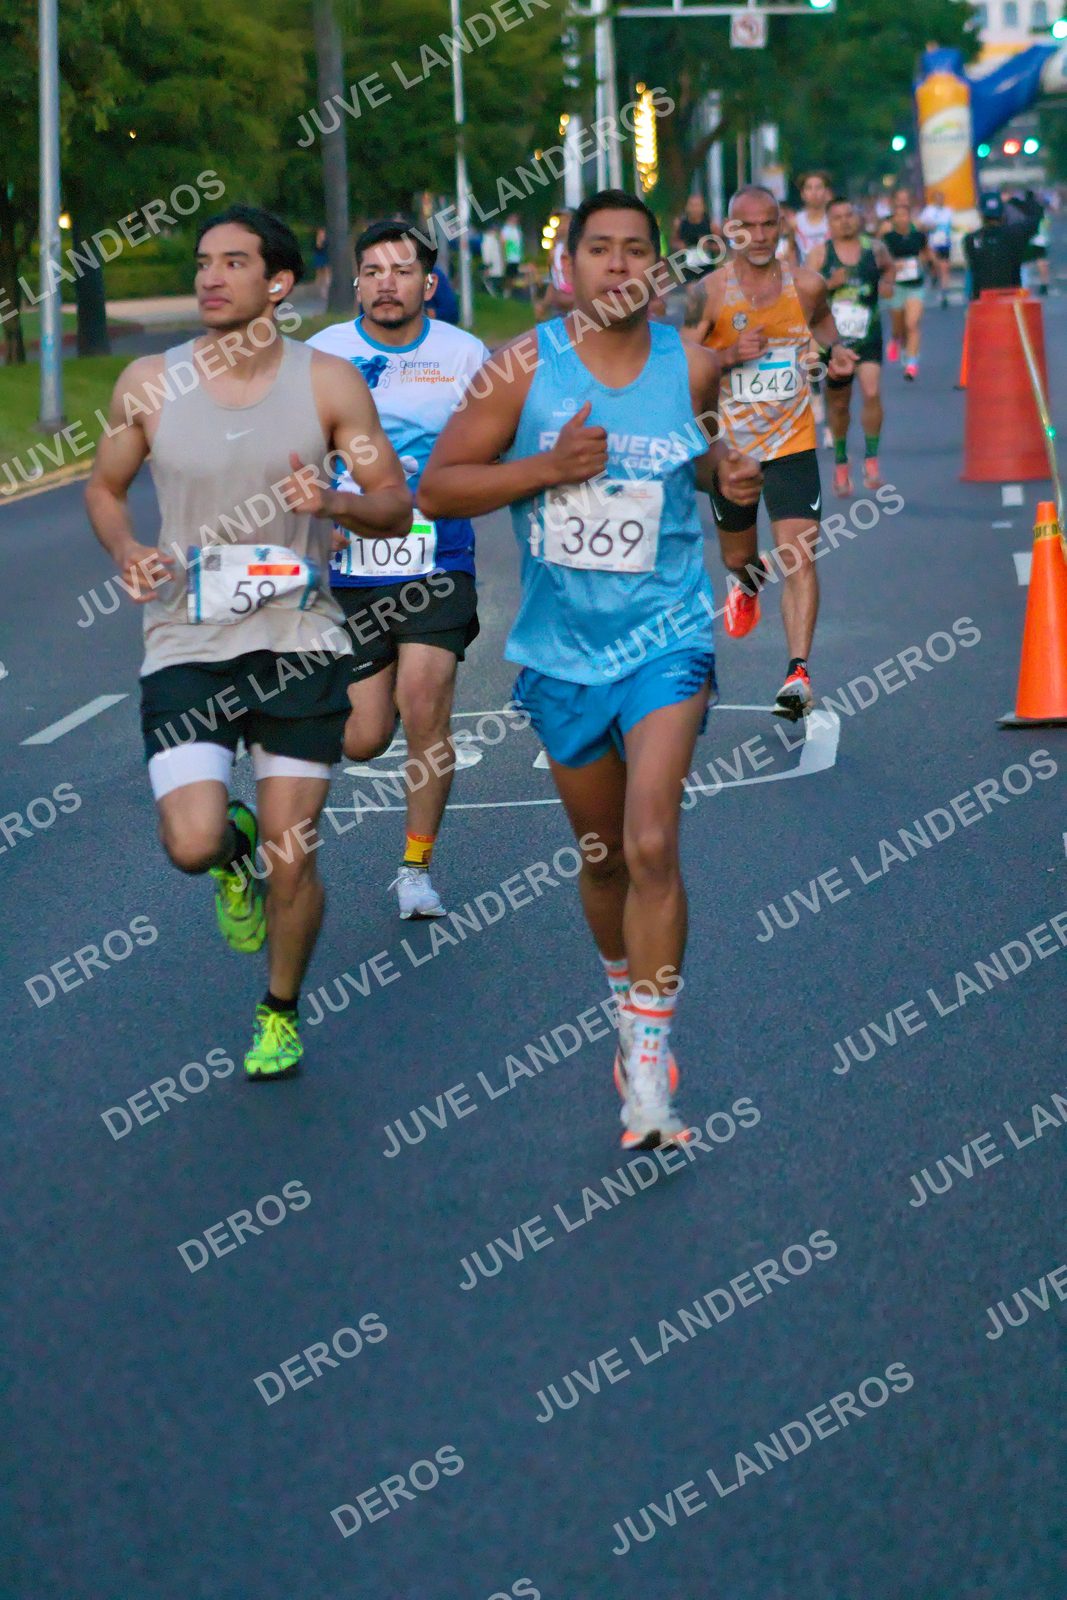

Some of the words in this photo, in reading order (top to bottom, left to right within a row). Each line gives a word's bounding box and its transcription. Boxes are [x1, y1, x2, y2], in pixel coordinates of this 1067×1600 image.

[736, 369, 797, 395] 1642
[355, 537, 426, 566] 1061
[561, 516, 644, 558] 369
